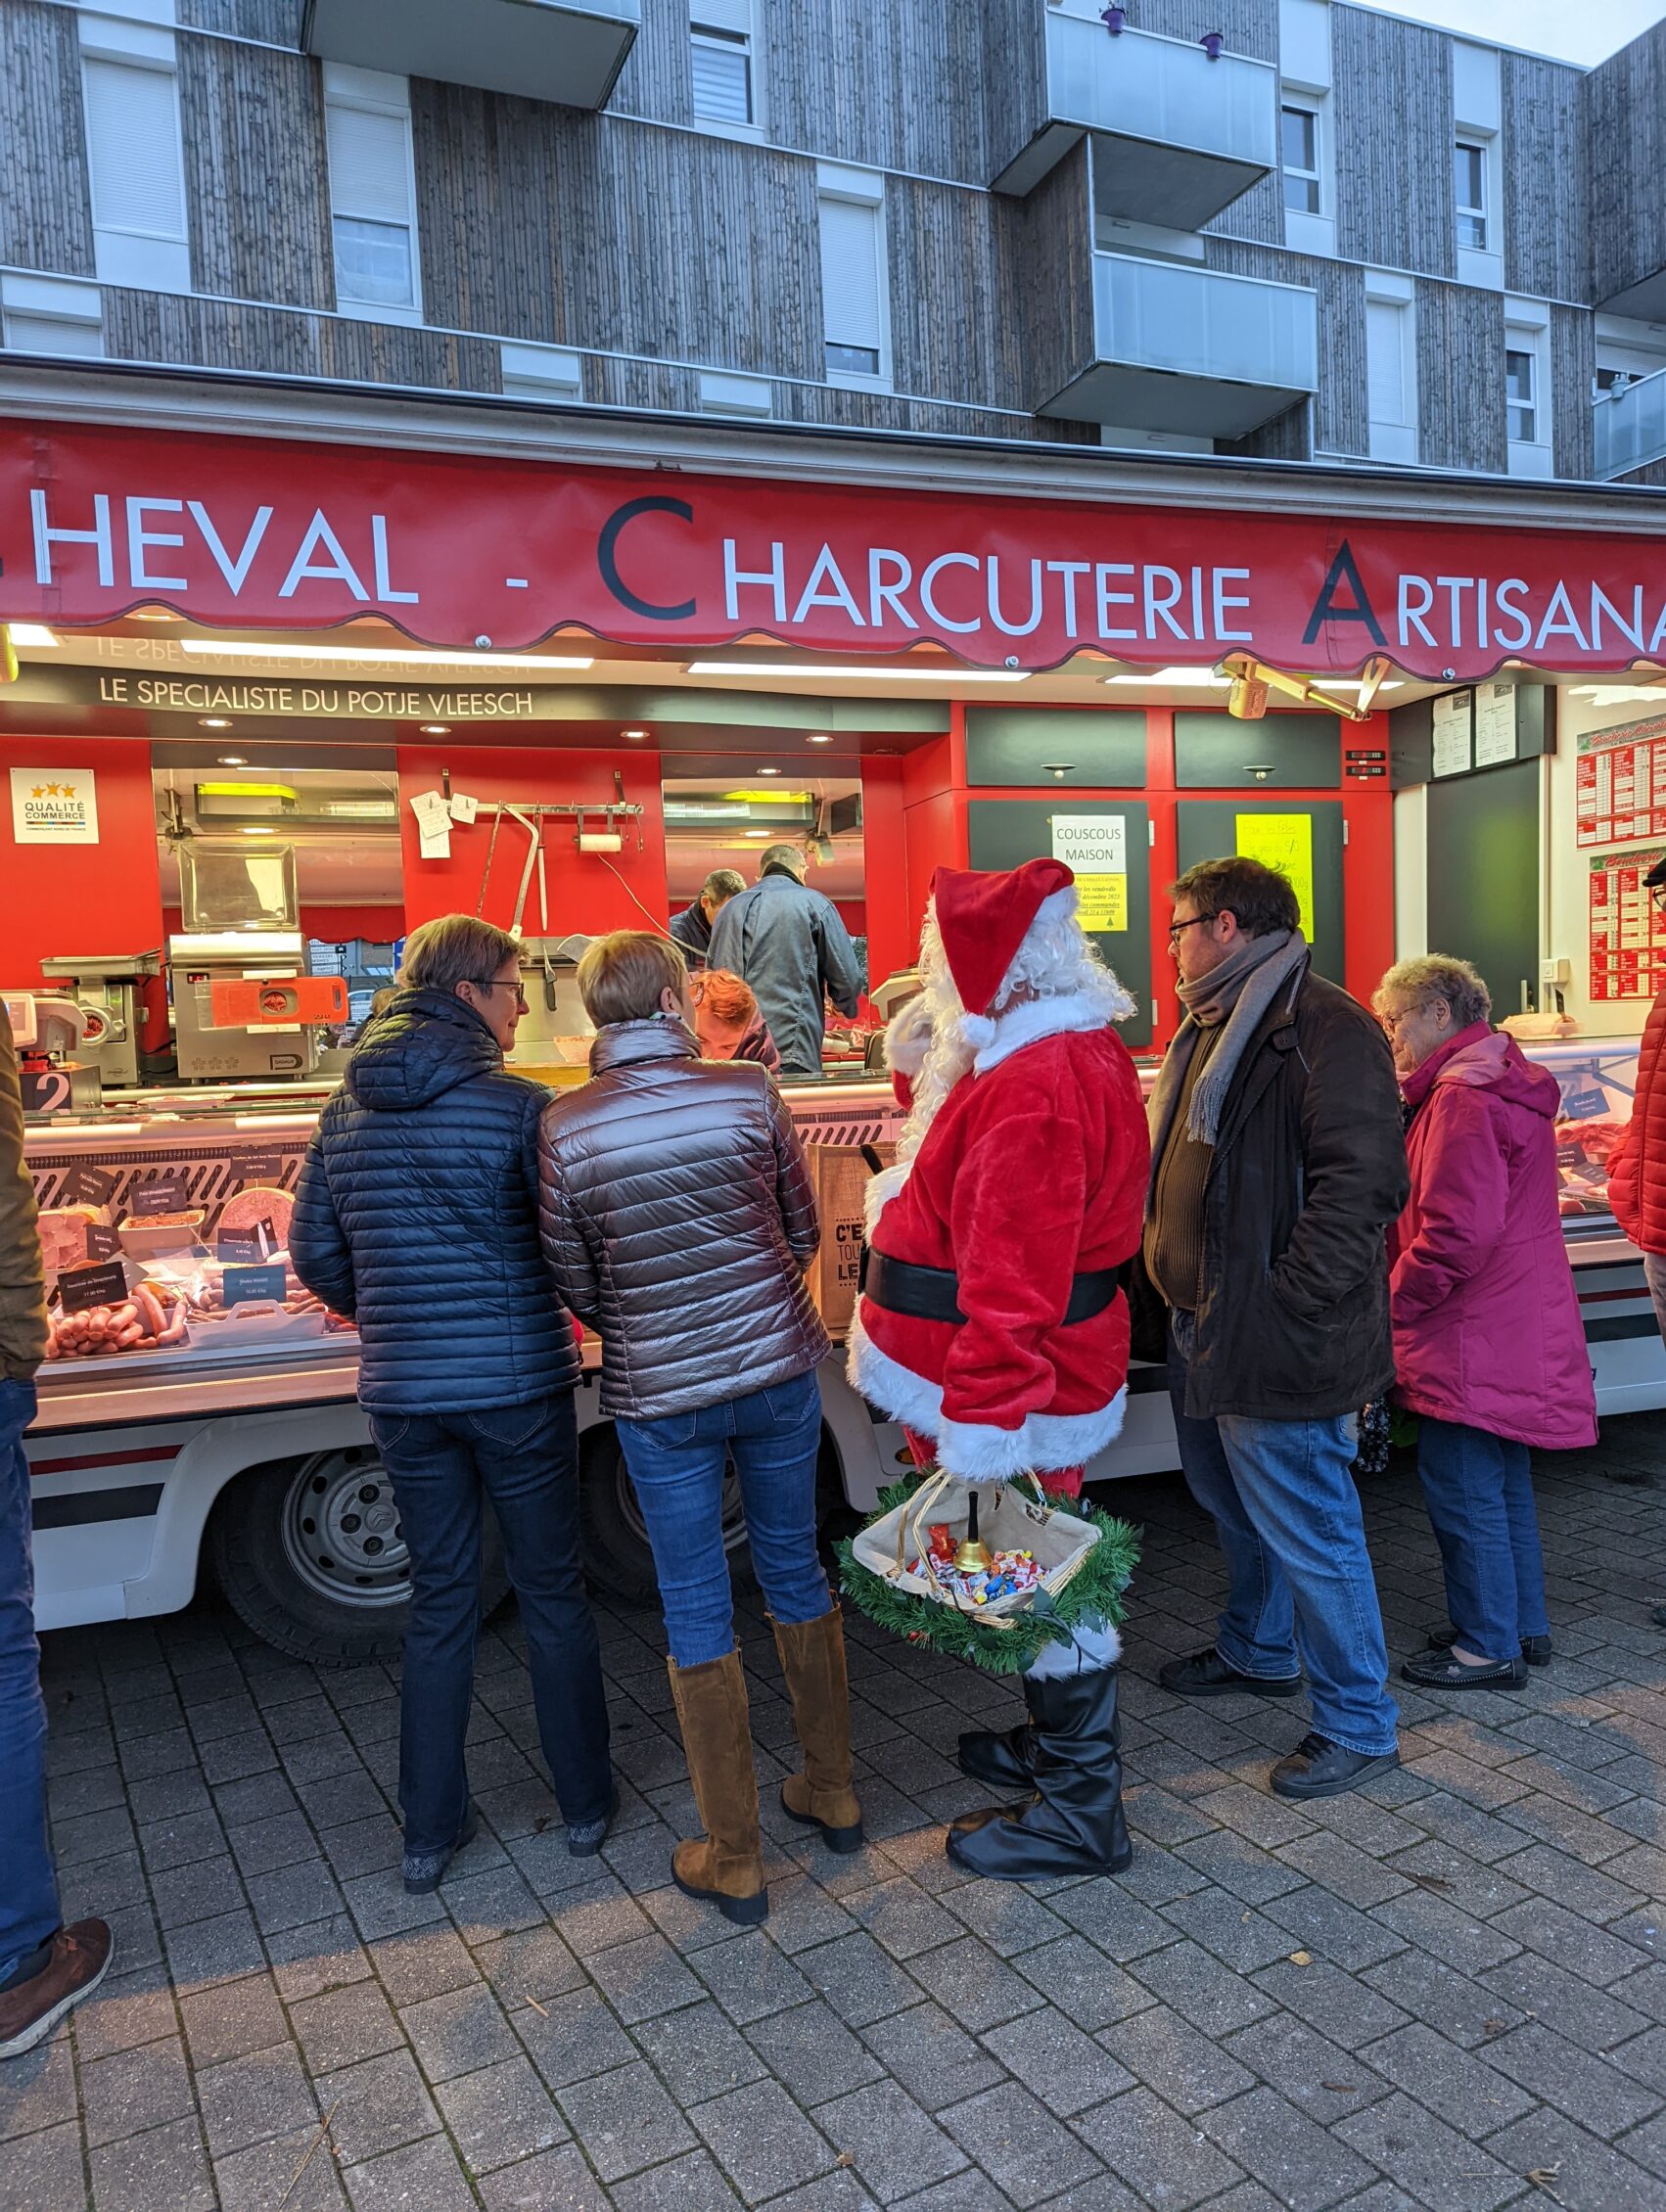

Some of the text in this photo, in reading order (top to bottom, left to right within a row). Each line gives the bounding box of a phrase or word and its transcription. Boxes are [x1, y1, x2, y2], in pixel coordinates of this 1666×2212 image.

[0, 488, 419, 604] HEVAL
[100, 677, 533, 716] LE SPECIALISTE DU POTJE VLEESCH
[24, 801, 85, 812] QUALITÉ
[25, 811, 86, 820] COMMERCE
[1057, 828, 1122, 840] COUSCOUS
[1065, 849, 1114, 861] MAISON
[36, 1073, 71, 1116] 2
[836, 1222, 863, 1243] C'E
[837, 1244, 860, 1261] TOU
